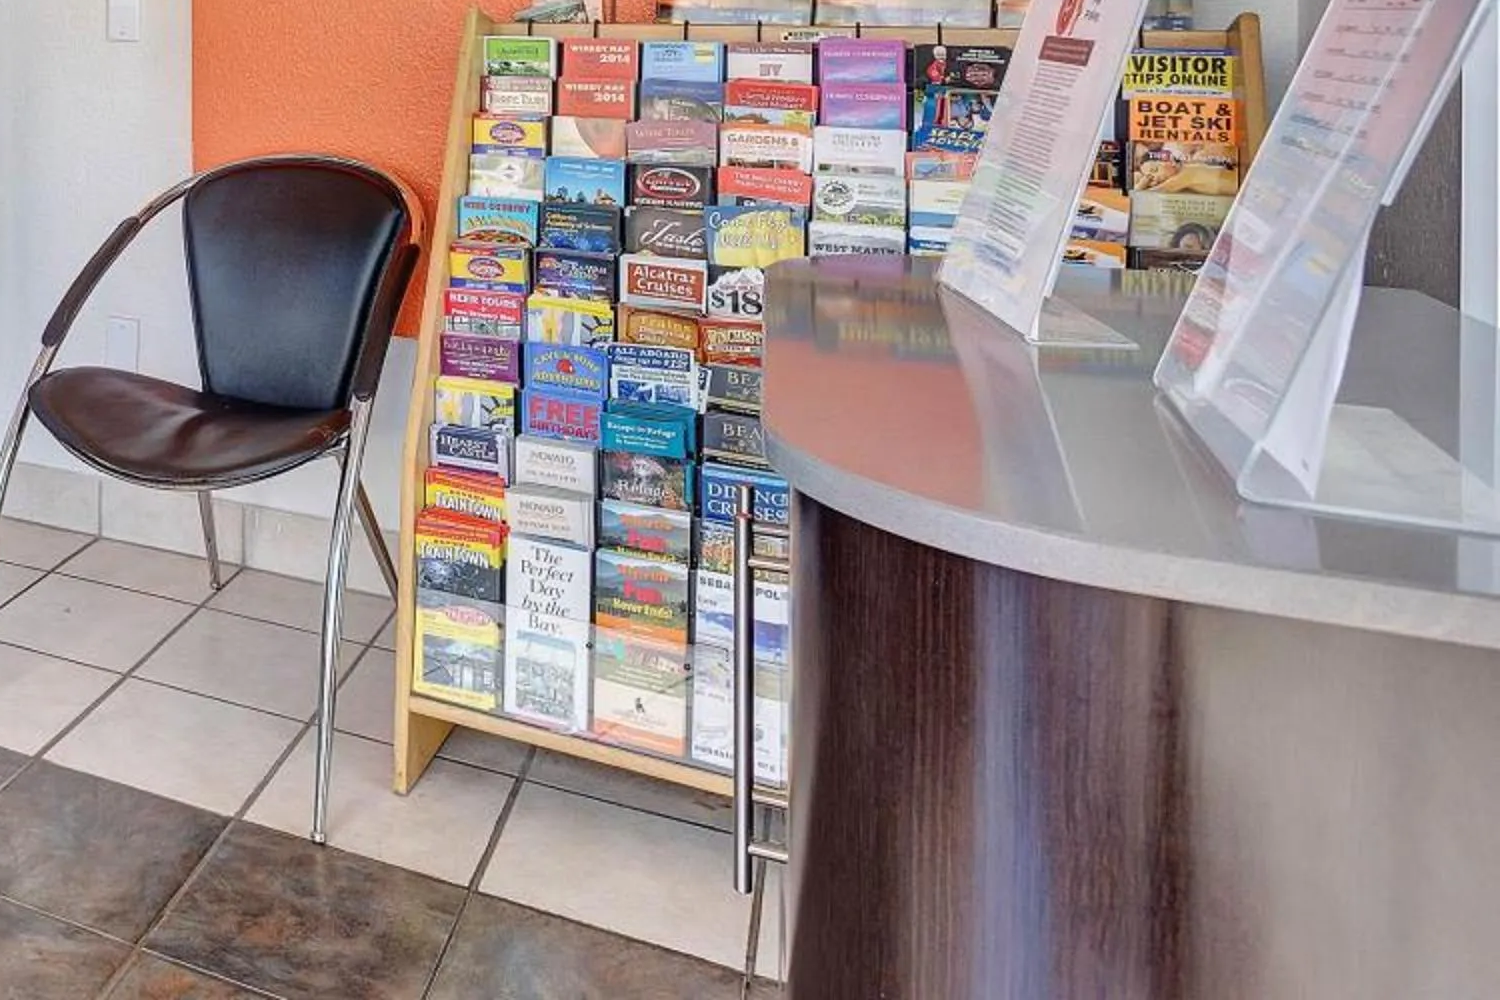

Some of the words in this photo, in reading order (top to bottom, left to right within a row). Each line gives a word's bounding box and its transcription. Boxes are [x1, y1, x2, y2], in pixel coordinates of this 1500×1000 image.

[1131, 55, 1227, 75] VISITOR
[1170, 73, 1227, 87] ONLINE
[1138, 101, 1206, 116] BOAT
[1215, 104, 1232, 117] &
[1138, 116, 1182, 128] JET
[1191, 116, 1231, 131] SKI
[727, 134, 789, 147] GARDENS
[1140, 130, 1230, 143] RENTALS
[814, 242, 850, 253] WEST
[633, 264, 696, 283] Alcatraz
[637, 278, 693, 297] Cruises
[710, 289, 764, 316] $18
[614, 347, 636, 356] ALL
[639, 348, 689, 360] ABOARD
[529, 395, 599, 428] FREE
[439, 434, 489, 451] HEARST
[449, 444, 496, 461] CASTLE
[530, 450, 575, 466] NOVATO
[519, 500, 565, 515] NOVATO
[707, 499, 787, 522] CRSES
[531, 545, 563, 566] The
[521, 559, 574, 583] Perfect
[530, 578, 565, 599] Day
[521, 596, 542, 613] by
[544, 599, 571, 618] the
[529, 613, 563, 634] Bay.
